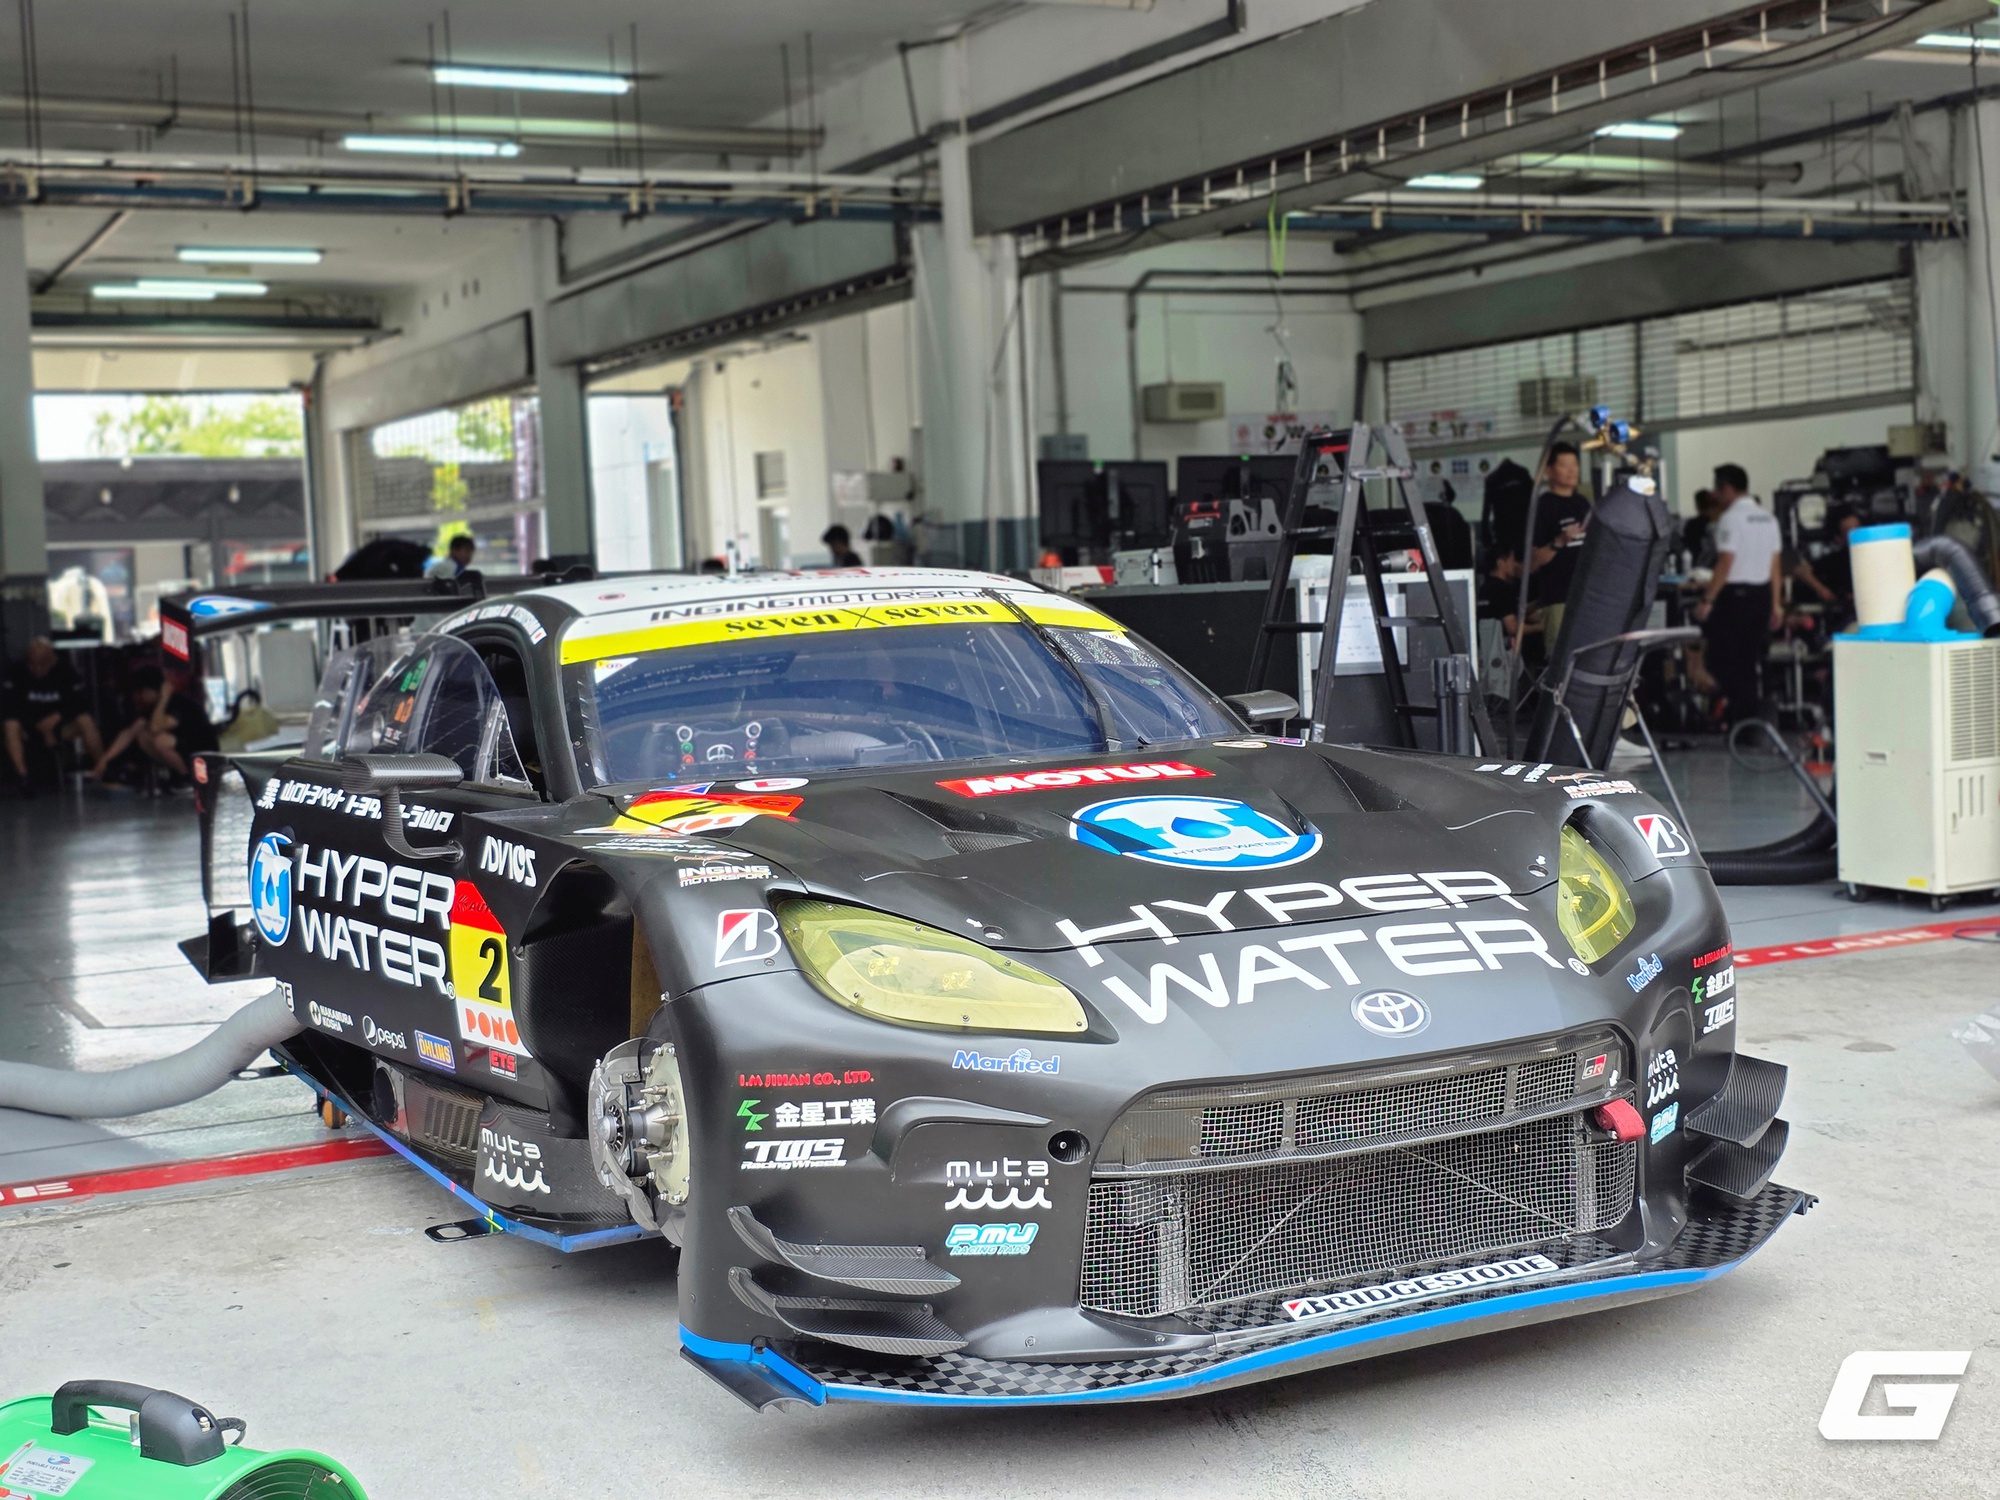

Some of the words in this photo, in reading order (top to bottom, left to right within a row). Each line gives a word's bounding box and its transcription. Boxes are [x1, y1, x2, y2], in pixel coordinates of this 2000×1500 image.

[725, 612, 840, 633] seven
[885, 603, 991, 620] seven
[965, 763, 1196, 795] MOTUL
[1173, 845, 1232, 857] HYPER
[1232, 839, 1291, 851] WATER
[677, 865, 770, 879] INGING
[679, 872, 773, 888] MOTORSPORT
[298, 843, 456, 931] HYPER
[1055, 870, 1530, 968] HYPER
[478, 937, 504, 1004] 2
[1626, 953, 1664, 993] Marfied
[319, 1004, 354, 1027] NAKAMURA
[322, 1017, 344, 1033] KOSHA
[418, 1033, 452, 1064] ÖHLINS
[952, 1047, 1061, 1074] Marfied
[490, 1050, 516, 1073] ETS
[1584, 1062, 1605, 1076] GR
[739, 1073, 763, 1087] I.M
[764, 1072, 811, 1088] JIHAN
[843, 1070, 875, 1084] LTD.
[774, 1097, 877, 1128] 金星工業
[481, 1127, 542, 1160] muta
[744, 1138, 845, 1163] TWS
[946, 1156, 1050, 1178] muta
[946, 1179, 1050, 1188] MARINE
[950, 1244, 997, 1256] RACING
[997, 1243, 1031, 1255] PADS
[1287, 1254, 1552, 1318] BRIDGESTONE
